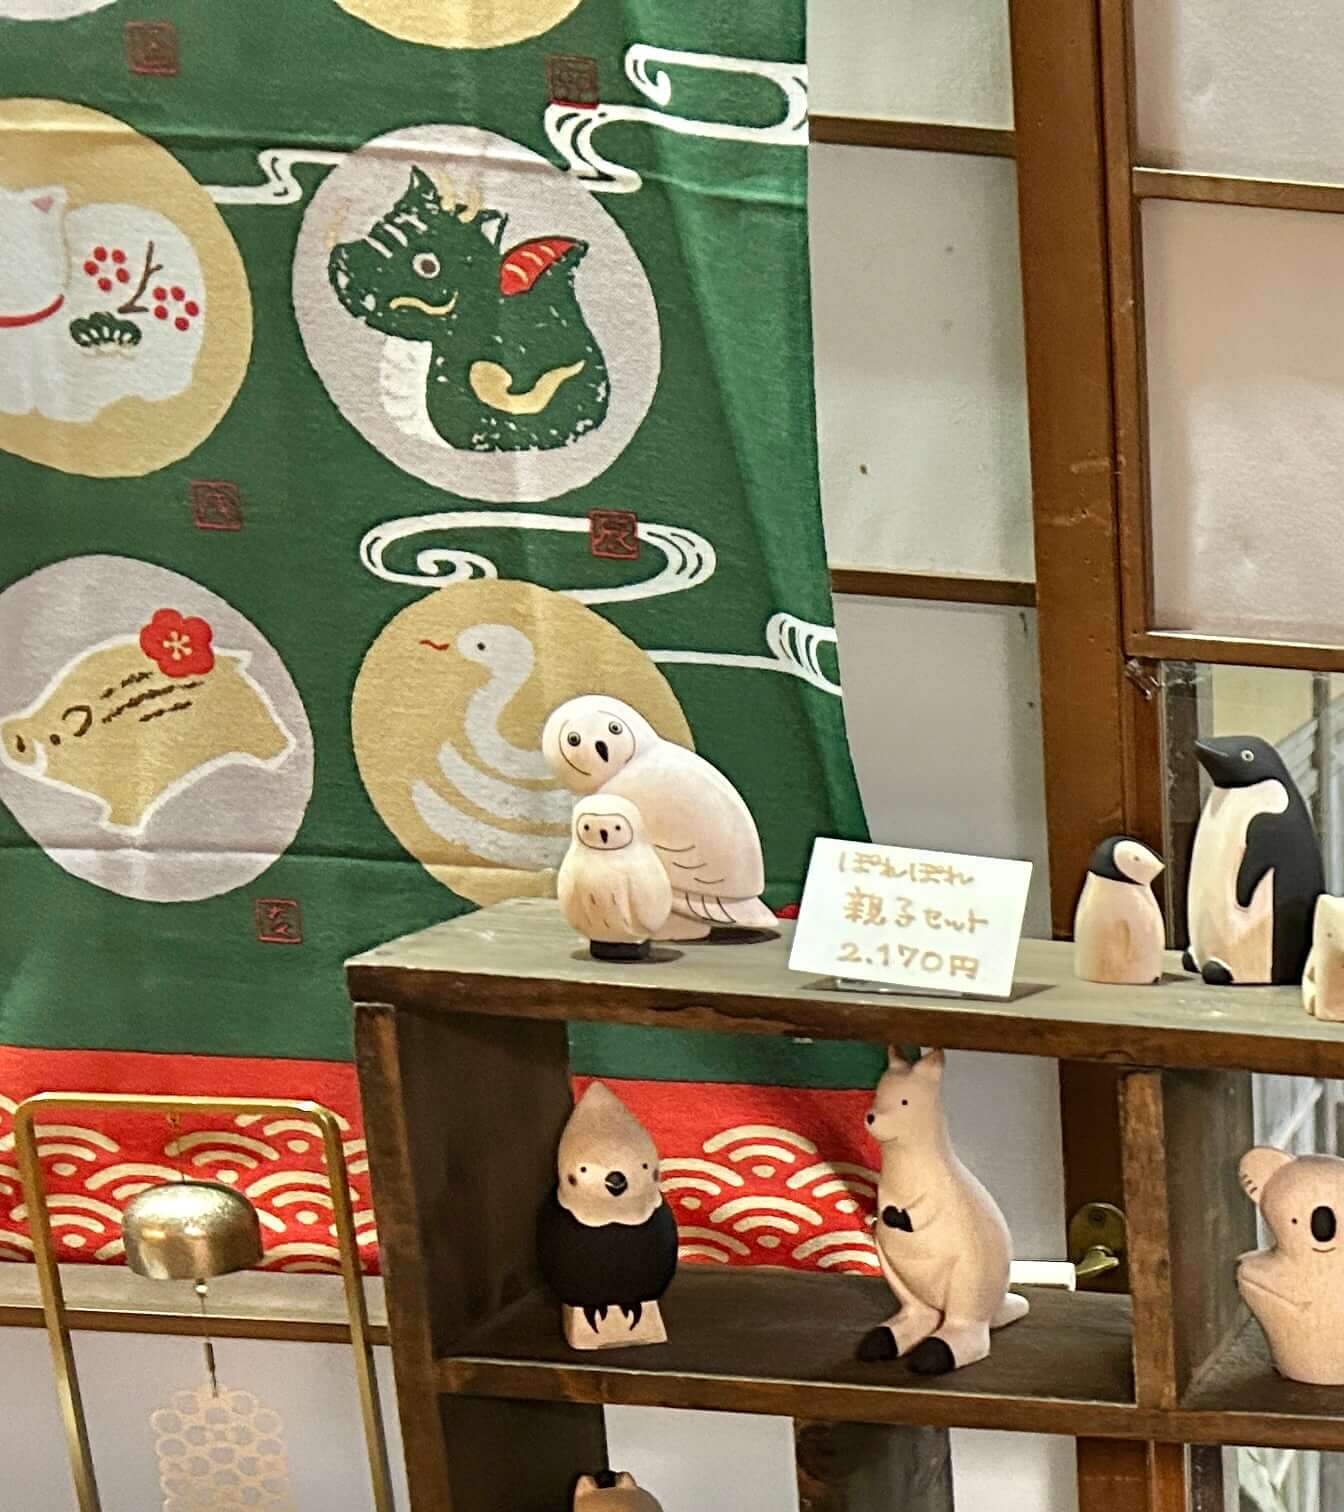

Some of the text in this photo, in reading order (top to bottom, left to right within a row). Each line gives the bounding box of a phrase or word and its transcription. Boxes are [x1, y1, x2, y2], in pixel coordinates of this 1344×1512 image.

[839, 851, 975, 886] ぽれぽれ
[842, 886, 989, 934] 親子セット
